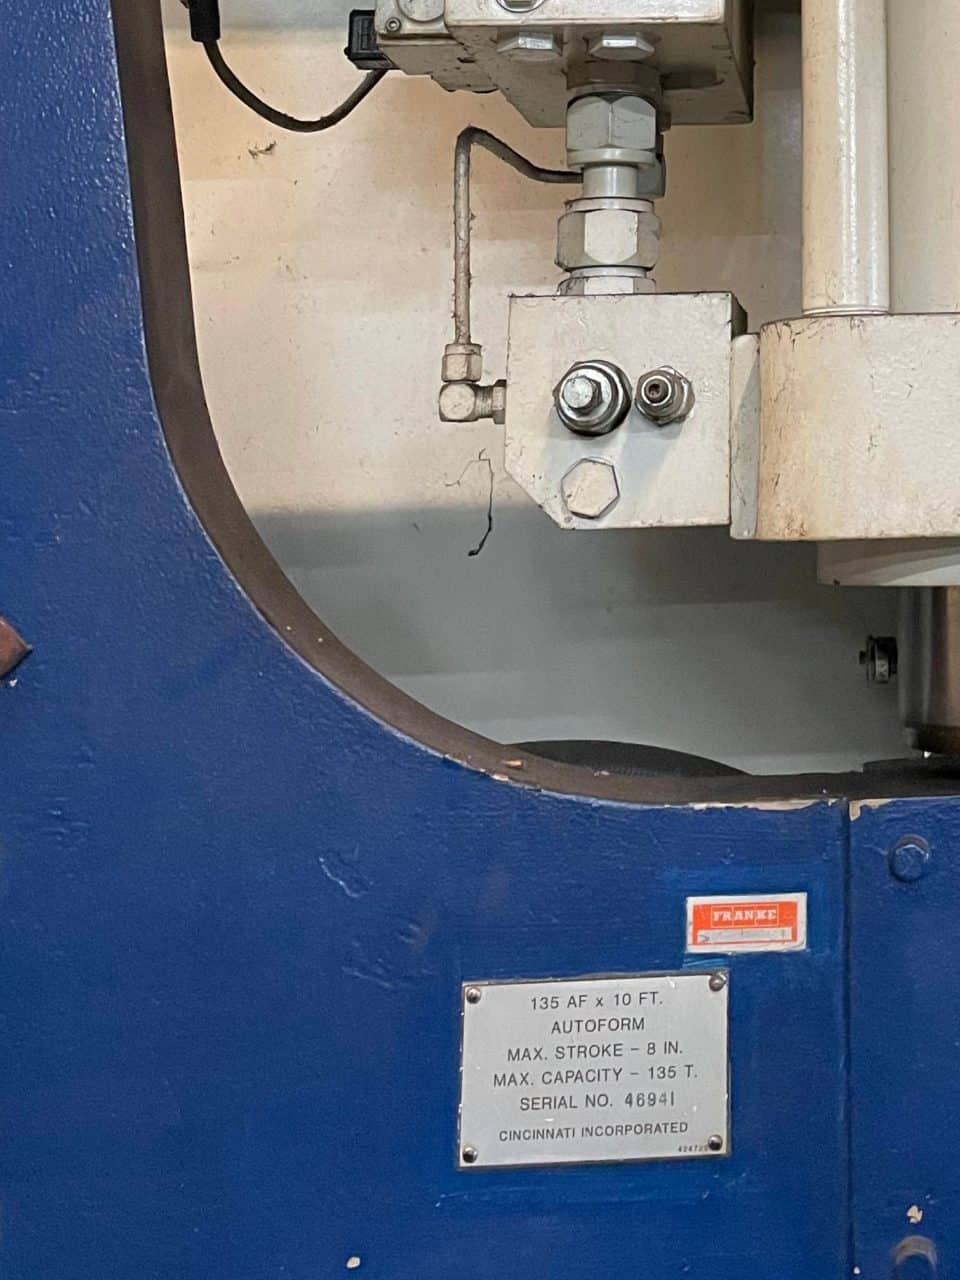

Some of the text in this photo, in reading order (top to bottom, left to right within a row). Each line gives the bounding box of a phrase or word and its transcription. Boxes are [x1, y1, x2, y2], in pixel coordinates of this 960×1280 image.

[713, 909, 777, 921] FRANKE
[531, 996, 559, 1010] 135
[567, 995, 587, 1008] AF
[614, 993, 632, 1006] 10
[639, 992, 663, 1005] FT.
[551, 1017, 645, 1034] AUTOFORM
[507, 1048, 548, 1062] MAX.
[555, 1043, 623, 1060] STROKE
[647, 1041, 656, 1055] 8
[664, 1040, 683, 1054] IN.
[493, 1073, 534, 1087] MAX.
[541, 1067, 623, 1085] CAPACITY
[648, 1065, 677, 1080] 135
[684, 1064, 698, 1078] T.
[520, 1091, 675, 1111] SERIAL NO. 46941
[499, 1122, 688, 1142] CINCINNATI INCORPORATED
